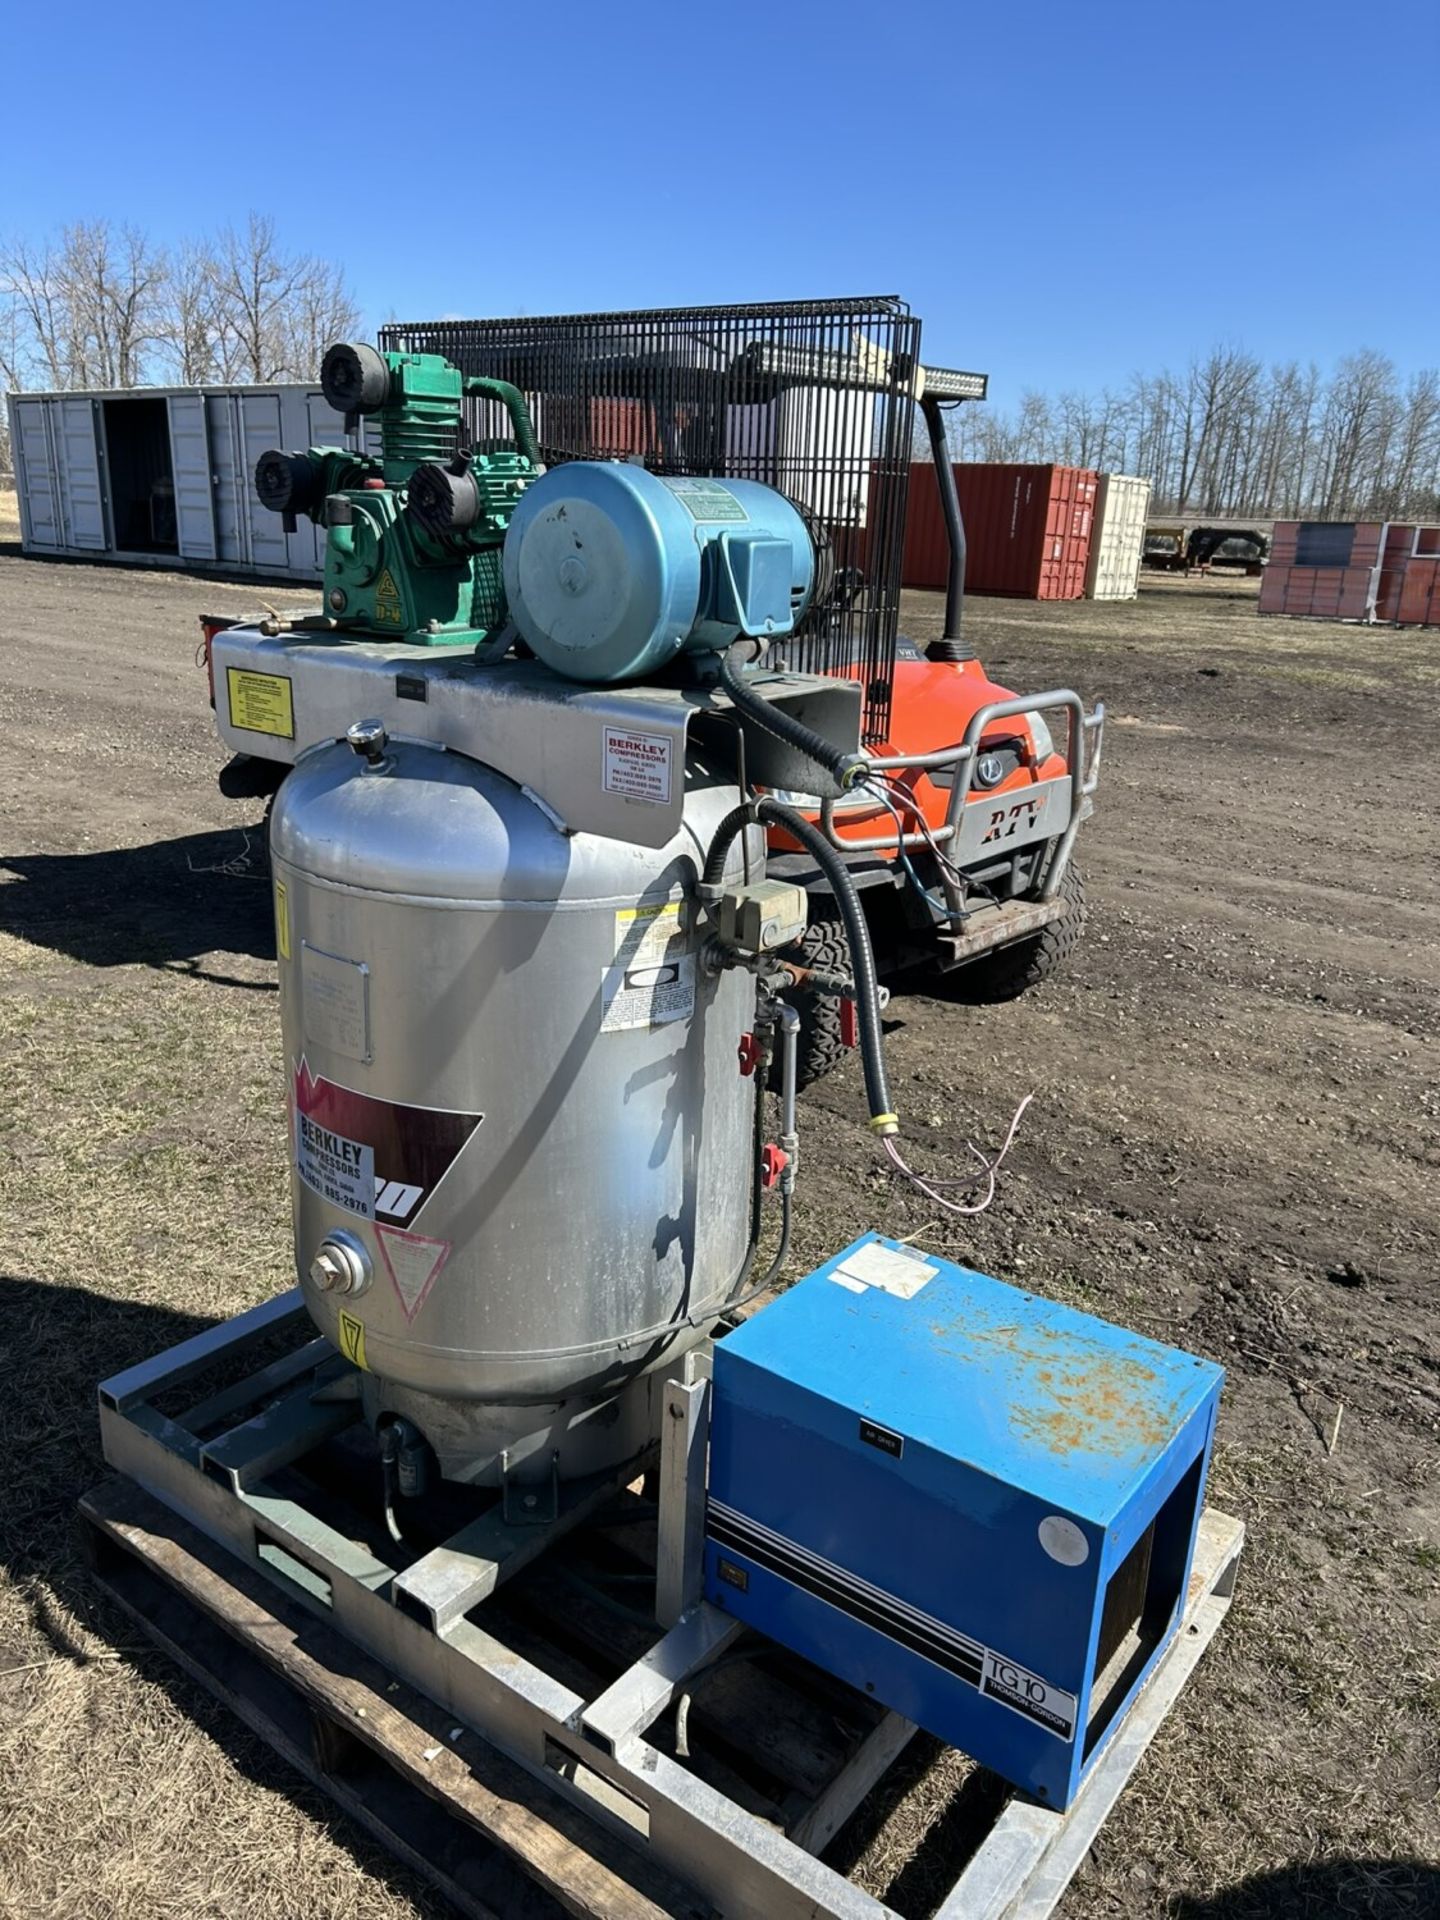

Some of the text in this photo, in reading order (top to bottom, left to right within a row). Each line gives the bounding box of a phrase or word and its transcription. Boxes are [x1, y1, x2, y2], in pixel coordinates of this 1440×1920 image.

[609, 738, 666, 755] BERKLEY
[609, 747, 666, 763] COMPRESSORS
[981, 796, 1047, 844] RTV
[301, 1115, 362, 1166] BERKLEY
[302, 1137, 360, 1180] COMPRESSORS
[990, 1681, 1066, 1728] THOMSON-GORDON
